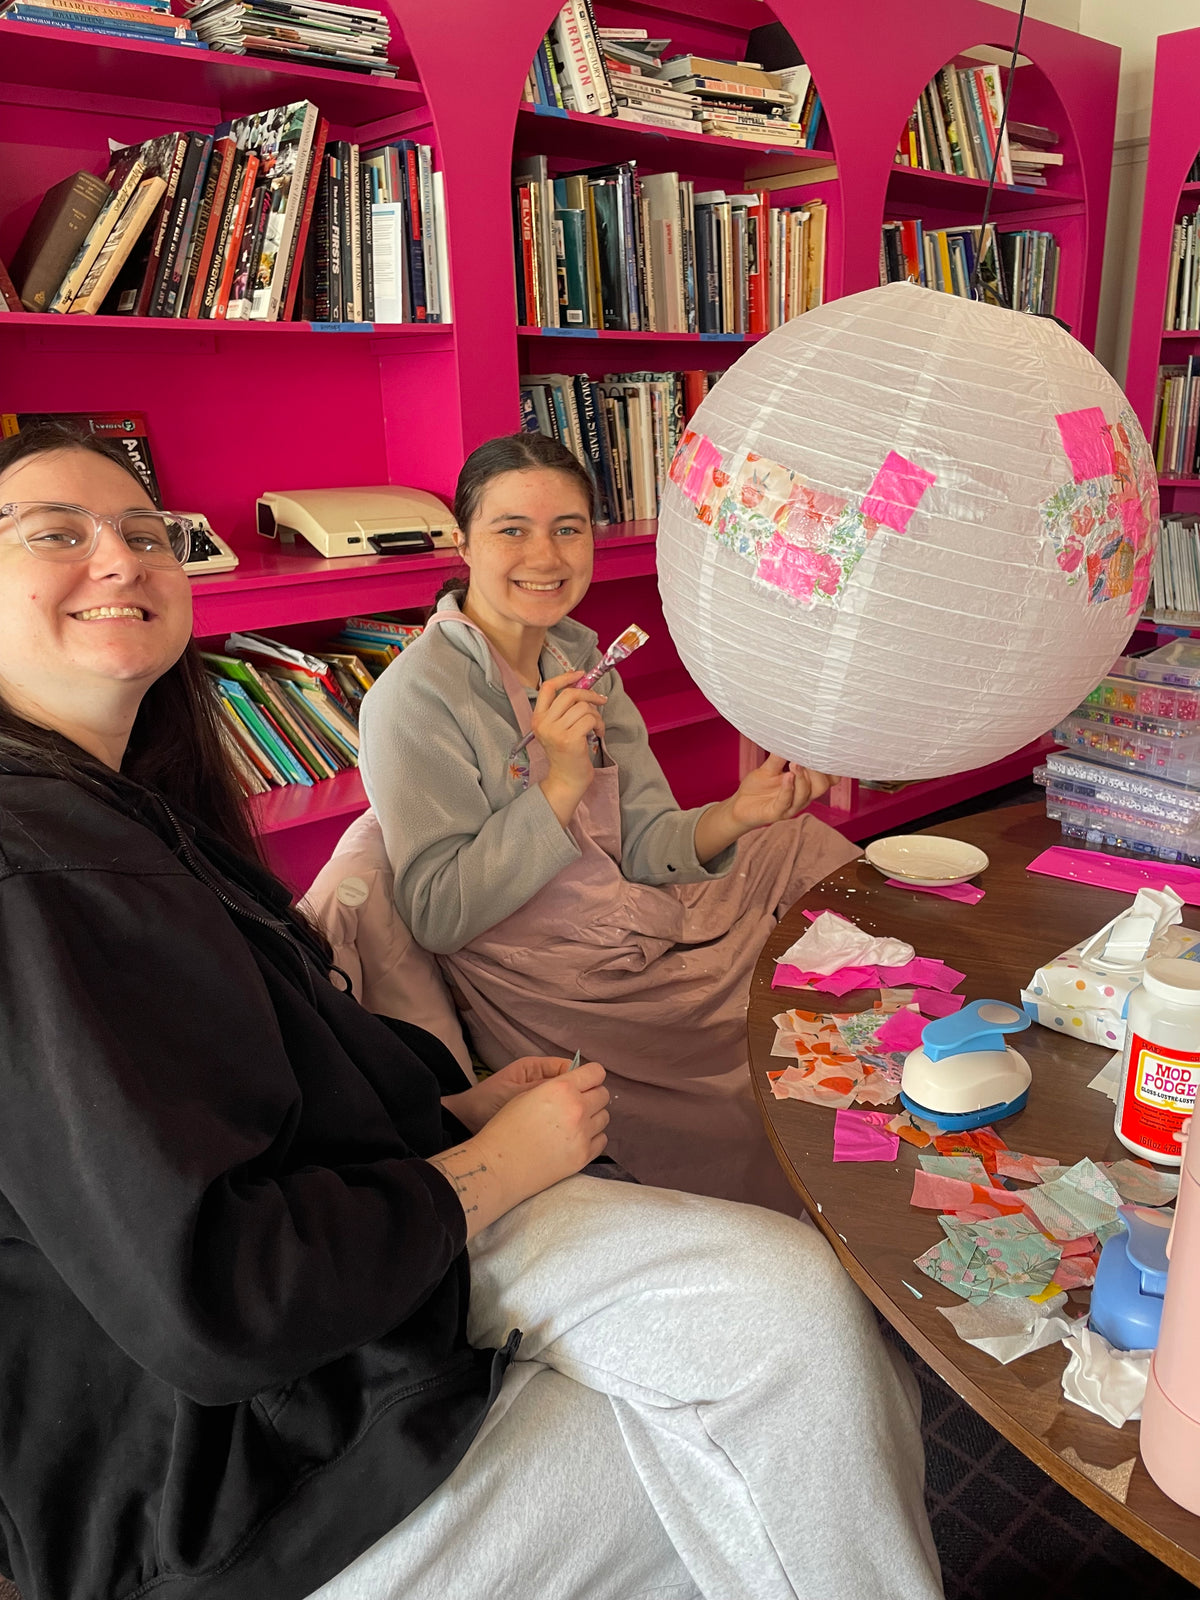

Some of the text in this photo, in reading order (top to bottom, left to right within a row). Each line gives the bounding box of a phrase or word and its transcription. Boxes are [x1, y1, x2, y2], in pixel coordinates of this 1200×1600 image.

[583, 24, 591, 39] THE
[587, 41, 601, 78] CENTURY
[591, 19, 604, 55] ANTIQUES
[166, 139, 187, 198] GHOST TOWNS
[176, 197, 188, 225] ZEALAND
[522, 198, 531, 240] ELVIS
[170, 242, 177, 251] OF
[172, 226, 180, 241] NEW
[330, 225, 341, 274] FIRSTS
[166, 253, 174, 266] LIFE
[204, 254, 222, 306] INVENTIONS
[581, 383, 595, 420] MOVIE
[1144, 1073, 1198, 1097] PODGE
[1156, 1063, 1191, 1083] MOD
